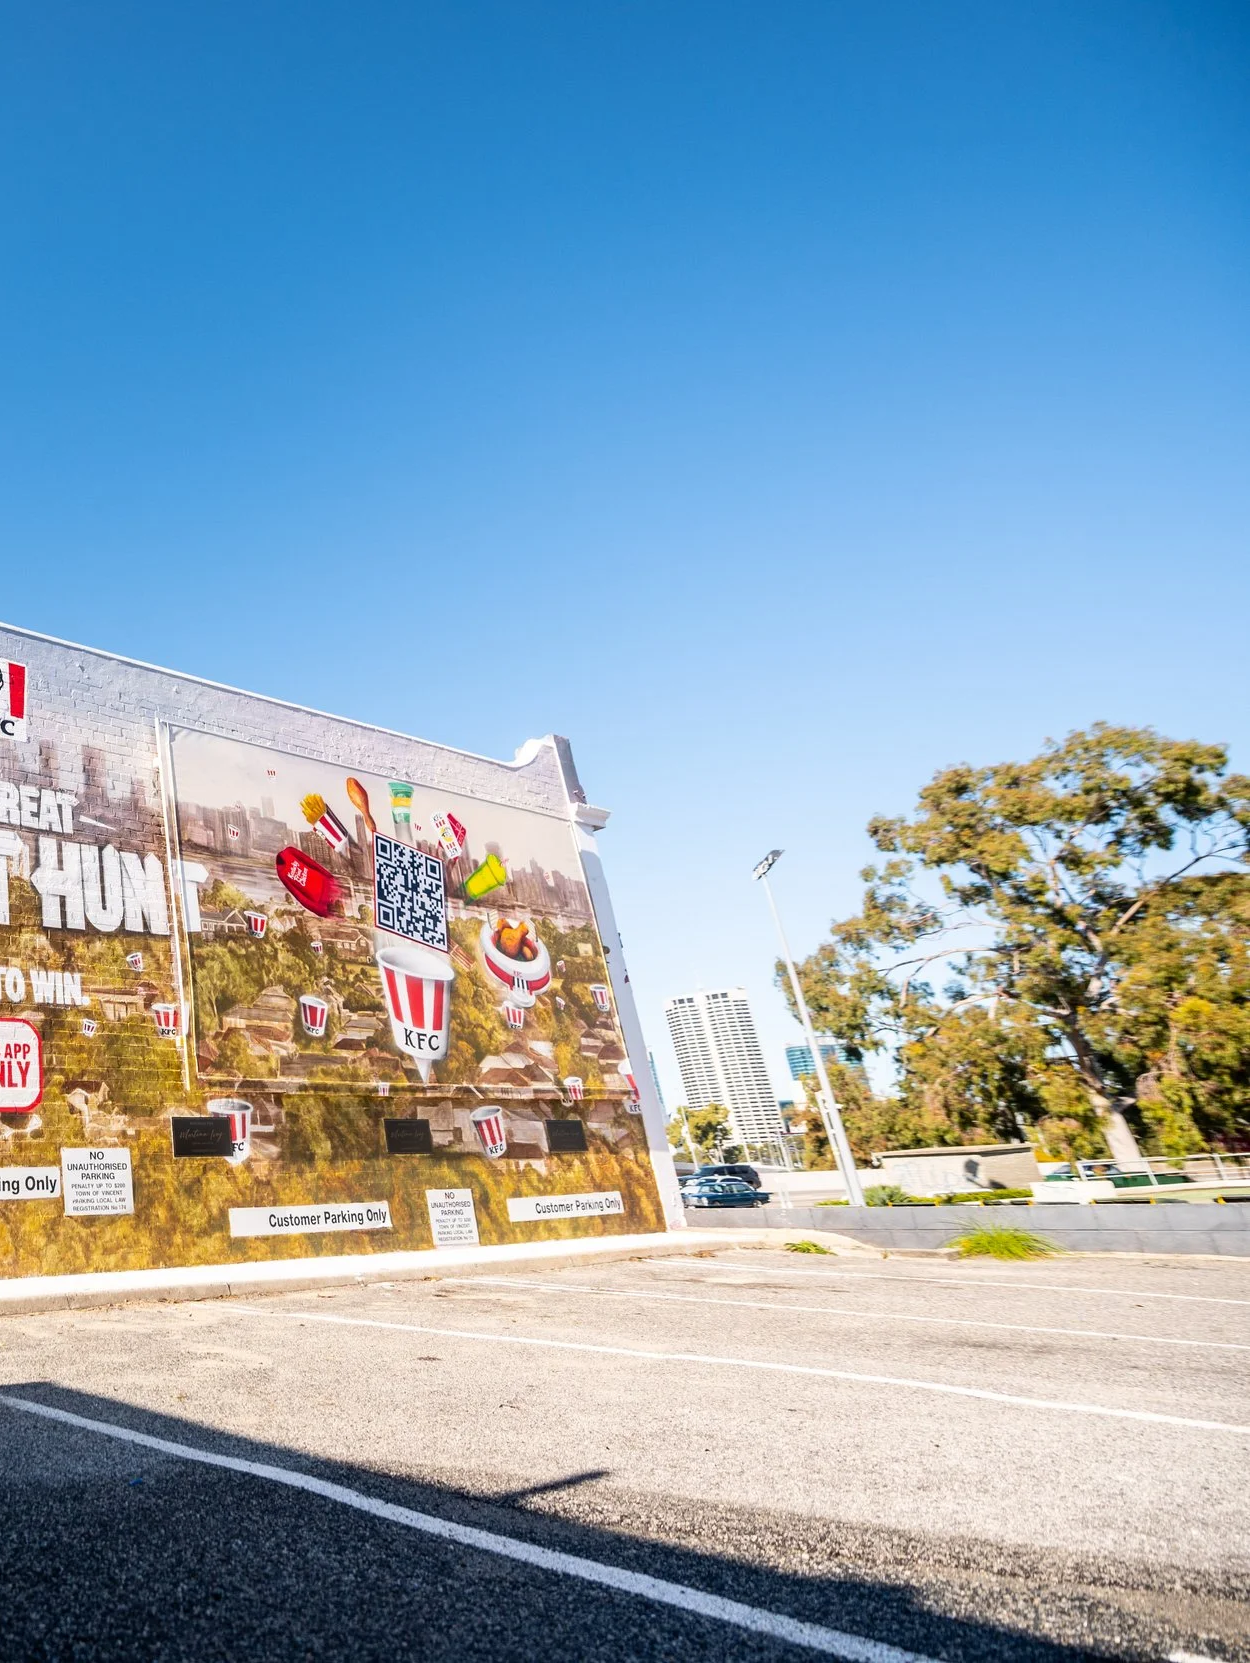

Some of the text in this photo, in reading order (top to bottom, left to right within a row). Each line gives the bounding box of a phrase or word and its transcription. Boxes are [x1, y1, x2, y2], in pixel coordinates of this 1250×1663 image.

[30, 835, 209, 936] HUNT
[30, 968, 91, 1007] WIN.
[160, 1028, 176, 1036] KFC
[403, 1027, 440, 1051] KFC
[4, 1043, 31, 1060] APP
[89, 1151, 105, 1160] NO
[488, 1144, 504, 1155] KFC
[66, 1162, 128, 1171] UNAUTHORISED
[81, 1172, 116, 1180] PARKING
[25, 1175, 58, 1194] Only
[444, 1191, 455, 1199] NO
[430, 1200, 471, 1209] UNAUTHORISED
[535, 1197, 621, 1214] Customer Parking Only
[268, 1208, 387, 1228] Customer Parking Only
